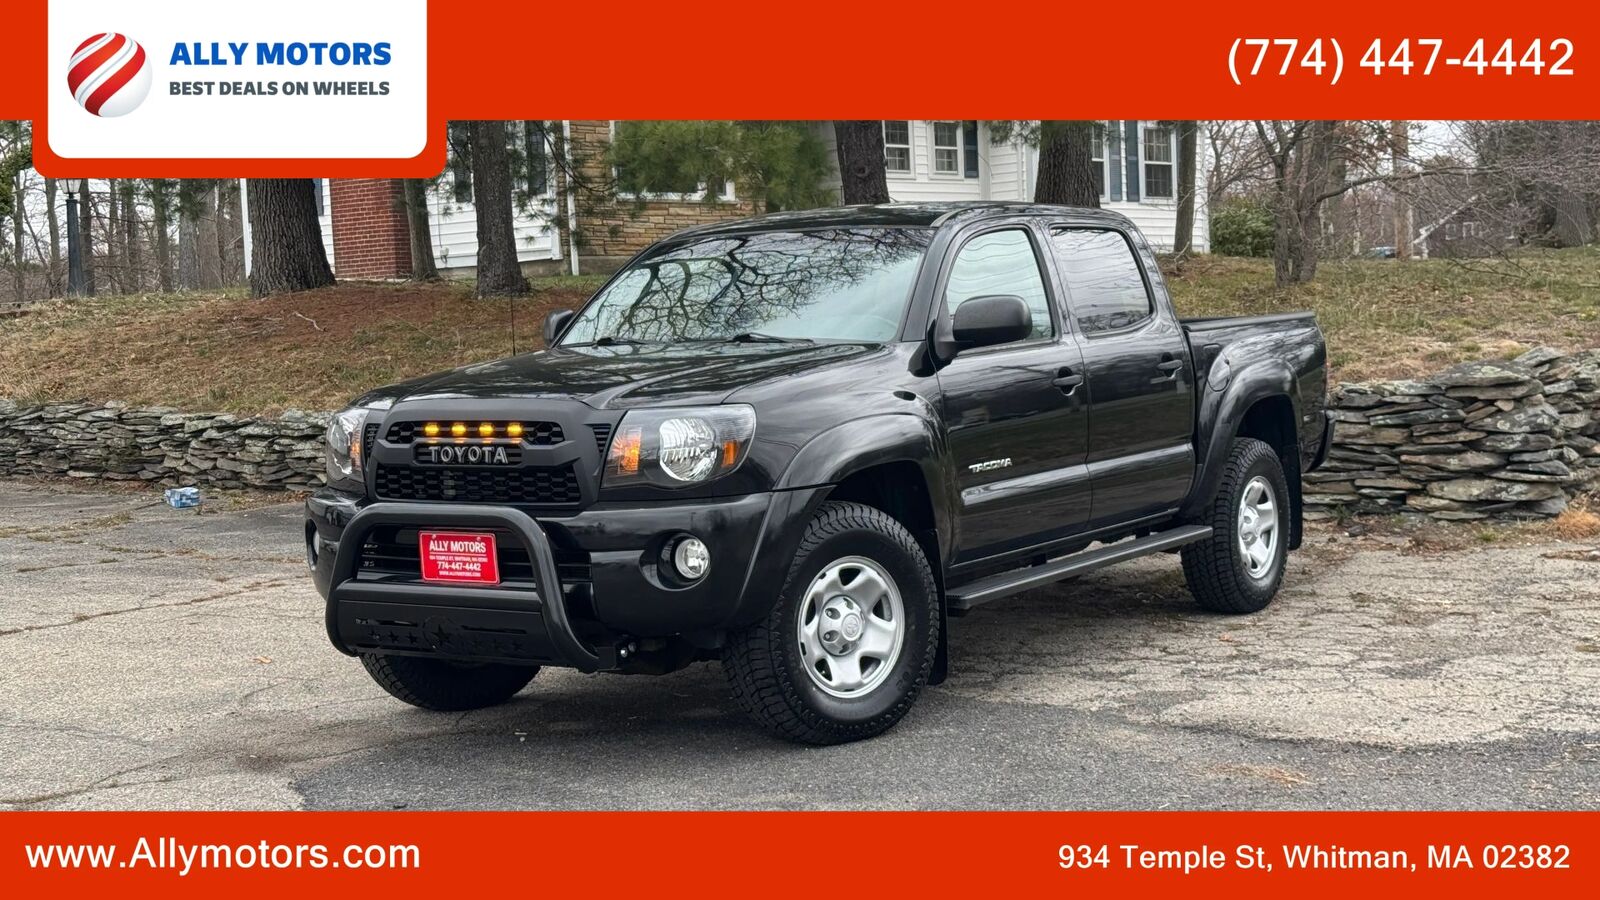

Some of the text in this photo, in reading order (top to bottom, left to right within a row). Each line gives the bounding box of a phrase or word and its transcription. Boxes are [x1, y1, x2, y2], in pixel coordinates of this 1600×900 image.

[428, 445, 508, 464] TOYOTA
[968, 457, 1013, 473] TACOMA
[429, 540, 486, 553] ALLY MOTORS
[437, 561, 482, 571] 774-447-4442
